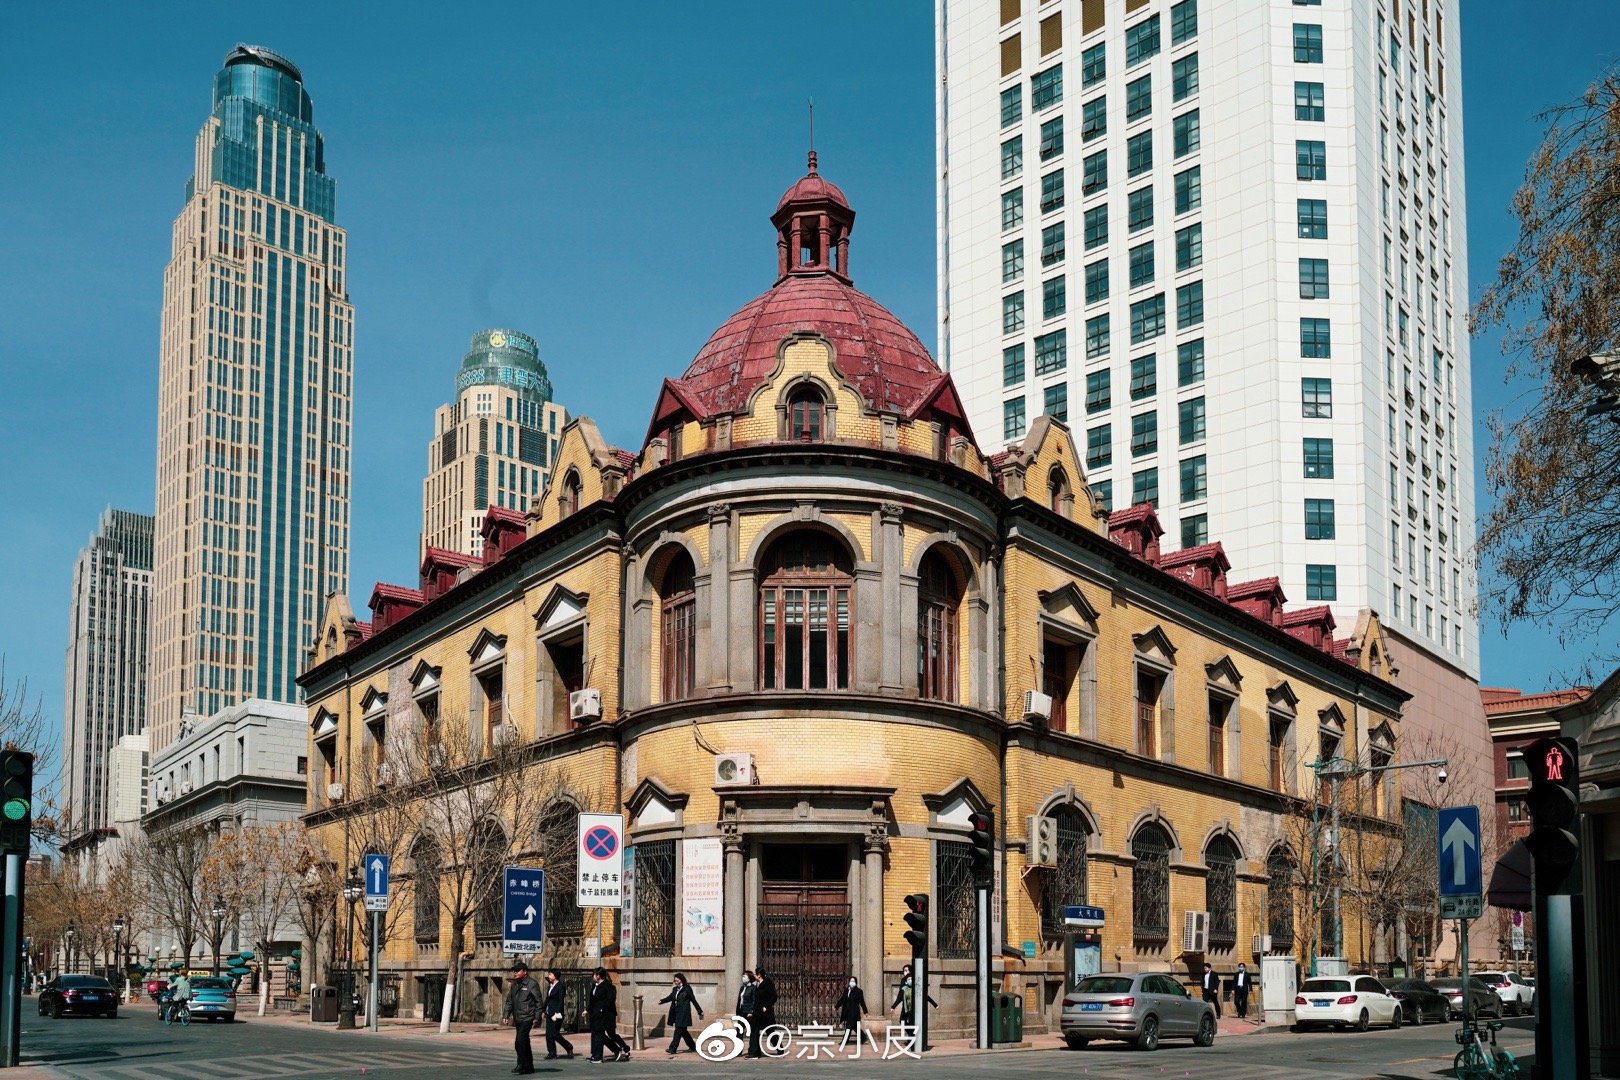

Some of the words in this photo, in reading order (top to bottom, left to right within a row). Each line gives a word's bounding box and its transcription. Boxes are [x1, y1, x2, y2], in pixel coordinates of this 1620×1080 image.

[582, 872, 619, 883] 禁止停车
[509, 942, 537, 951] 解放北路
